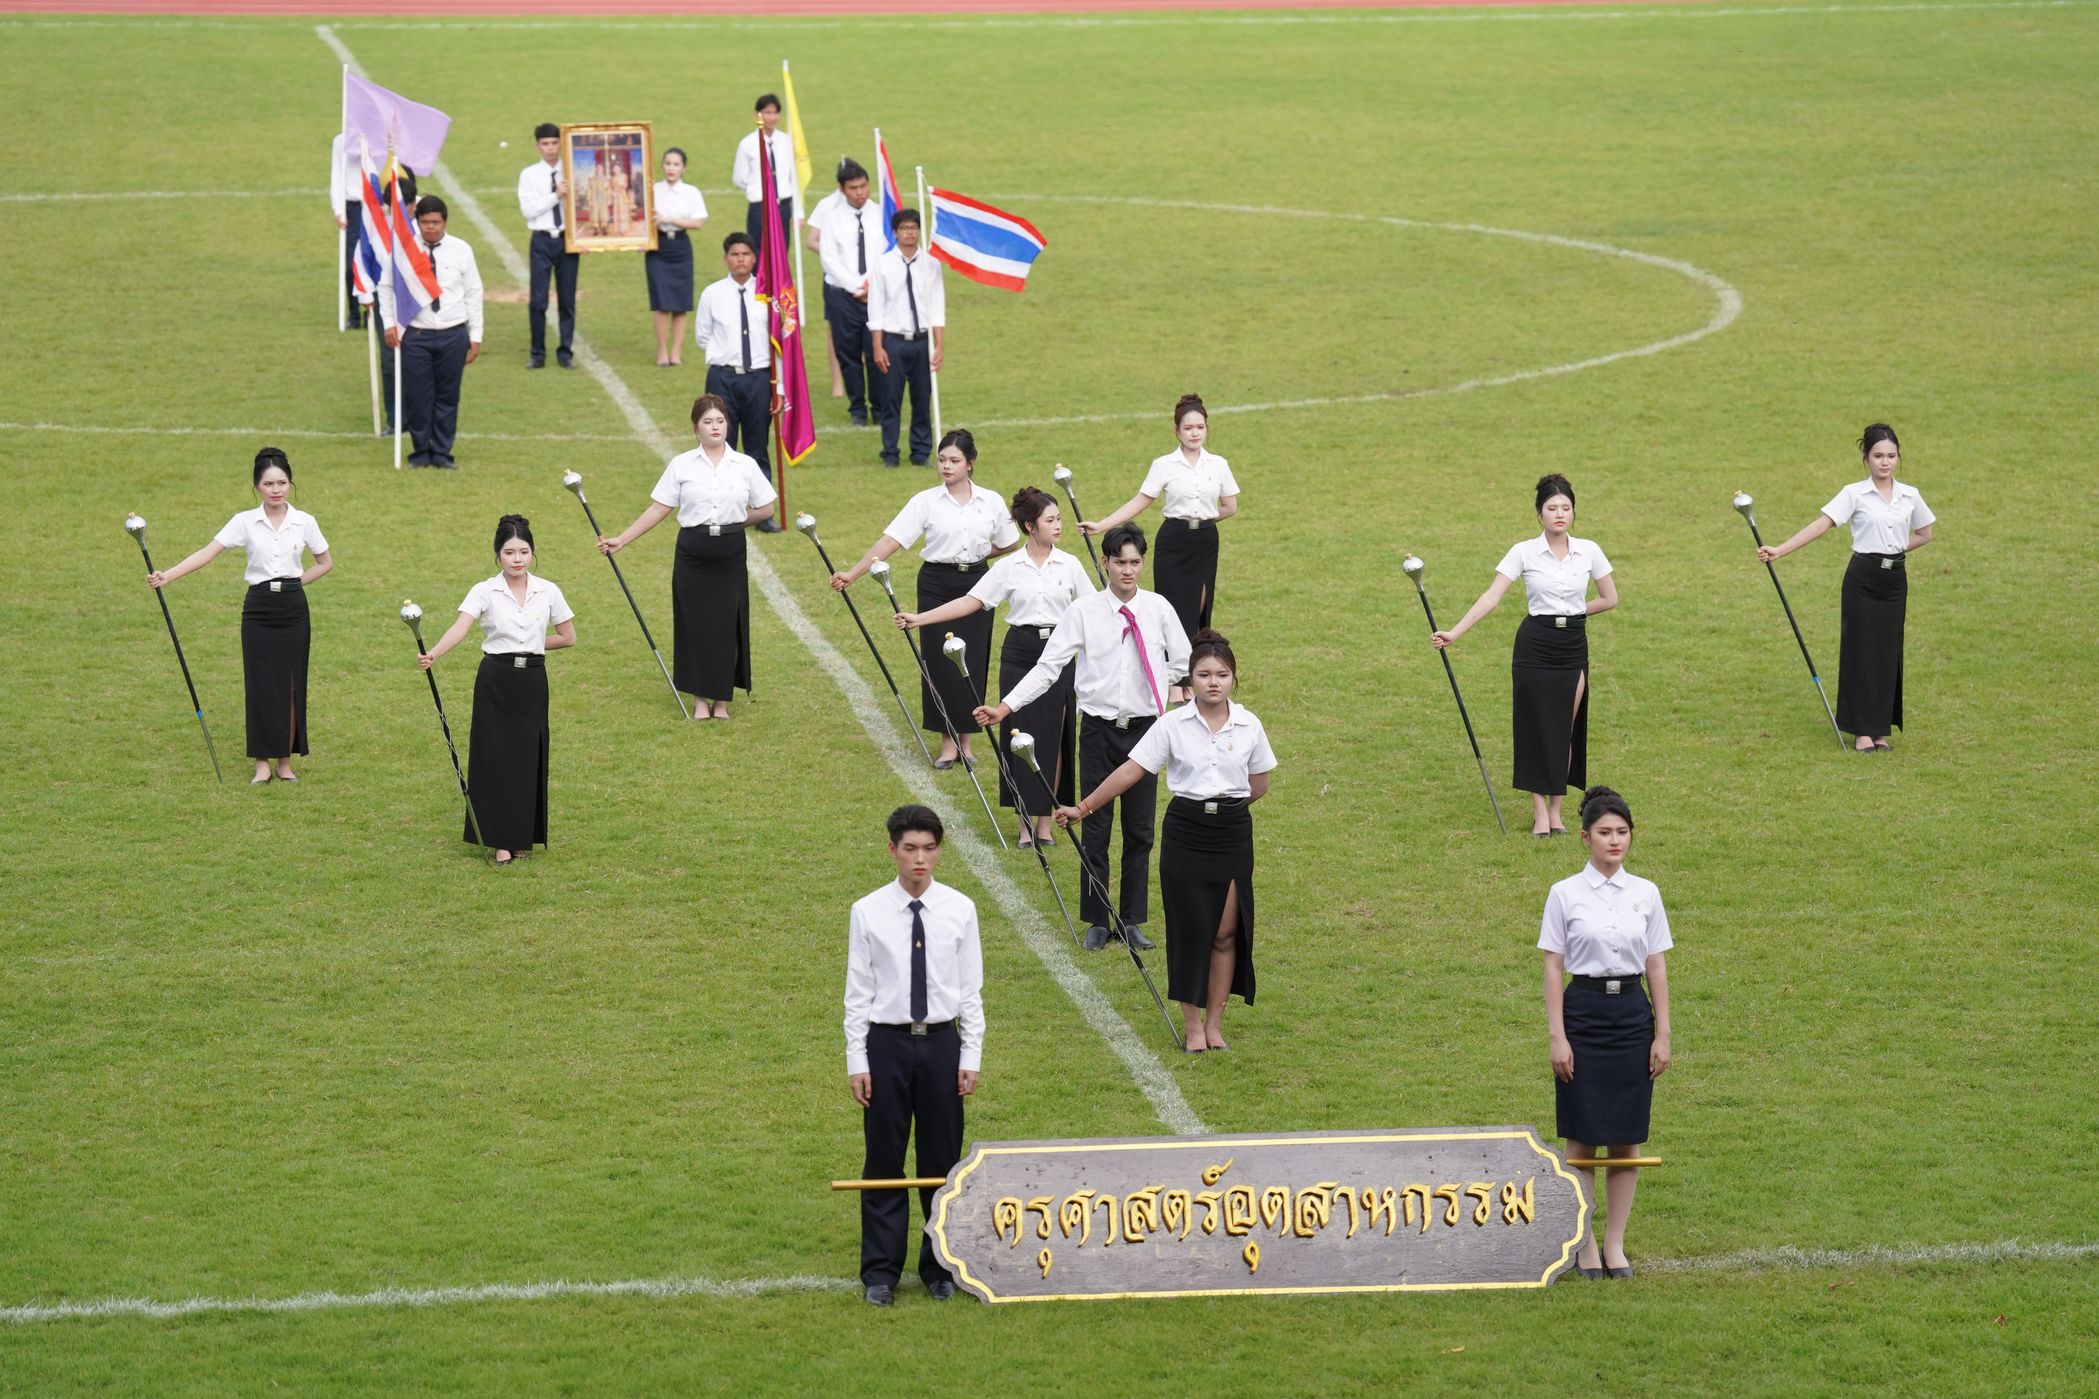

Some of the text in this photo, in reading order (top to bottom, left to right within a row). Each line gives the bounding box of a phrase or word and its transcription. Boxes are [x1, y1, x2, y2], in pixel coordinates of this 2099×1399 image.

[993, 1157, 1535, 1279] ครุศาสตร์อุตสาหกรรม
